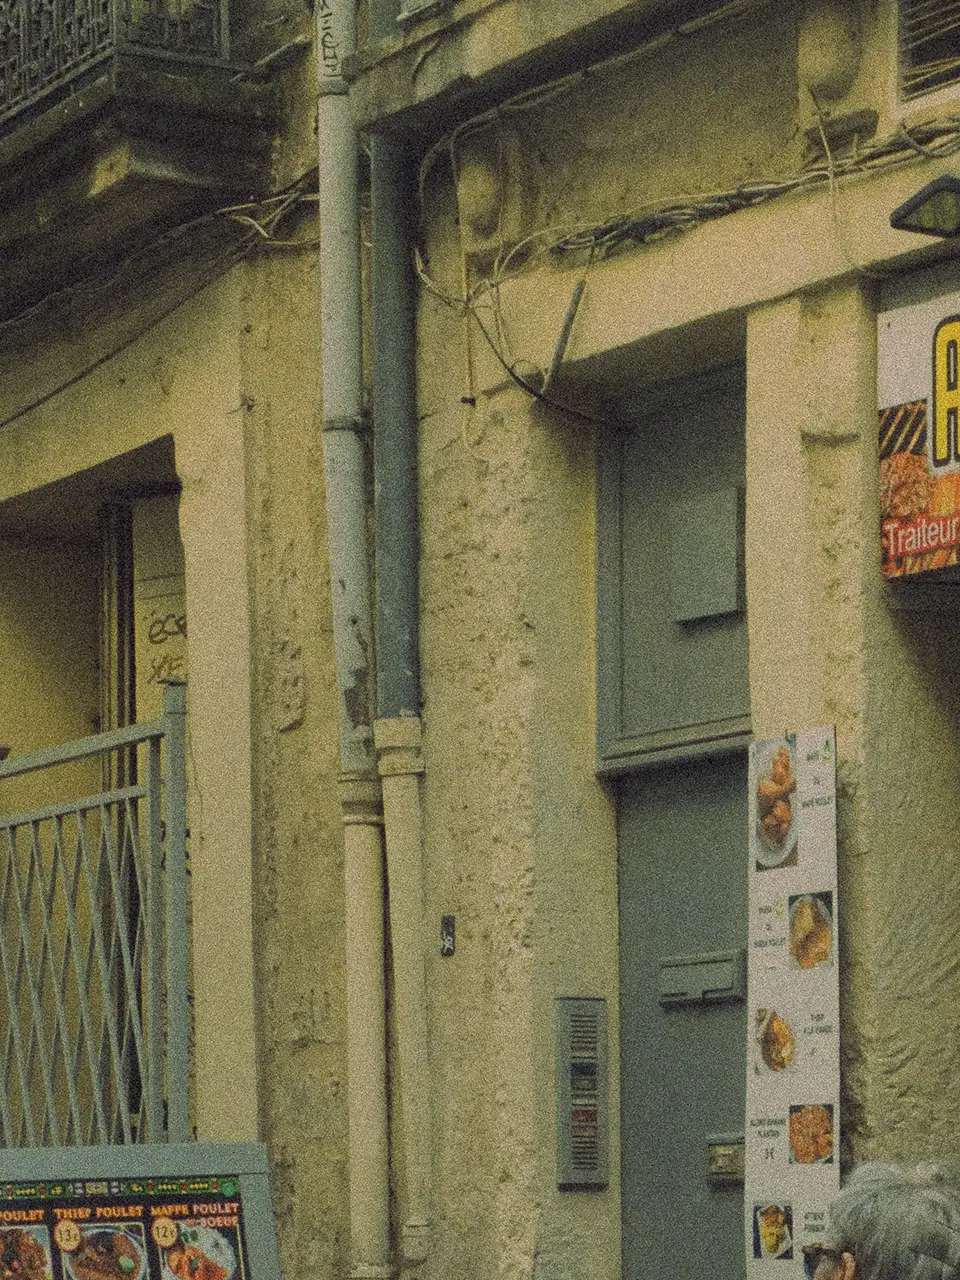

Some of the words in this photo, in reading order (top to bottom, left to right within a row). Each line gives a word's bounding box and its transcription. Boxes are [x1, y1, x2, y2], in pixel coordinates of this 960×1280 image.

[884, 514, 960, 558] Traiteur
[95, 1205, 144, 1219] POULET
[150, 1204, 190, 1217] MAFFE
[192, 1202, 240, 1215] POULET
